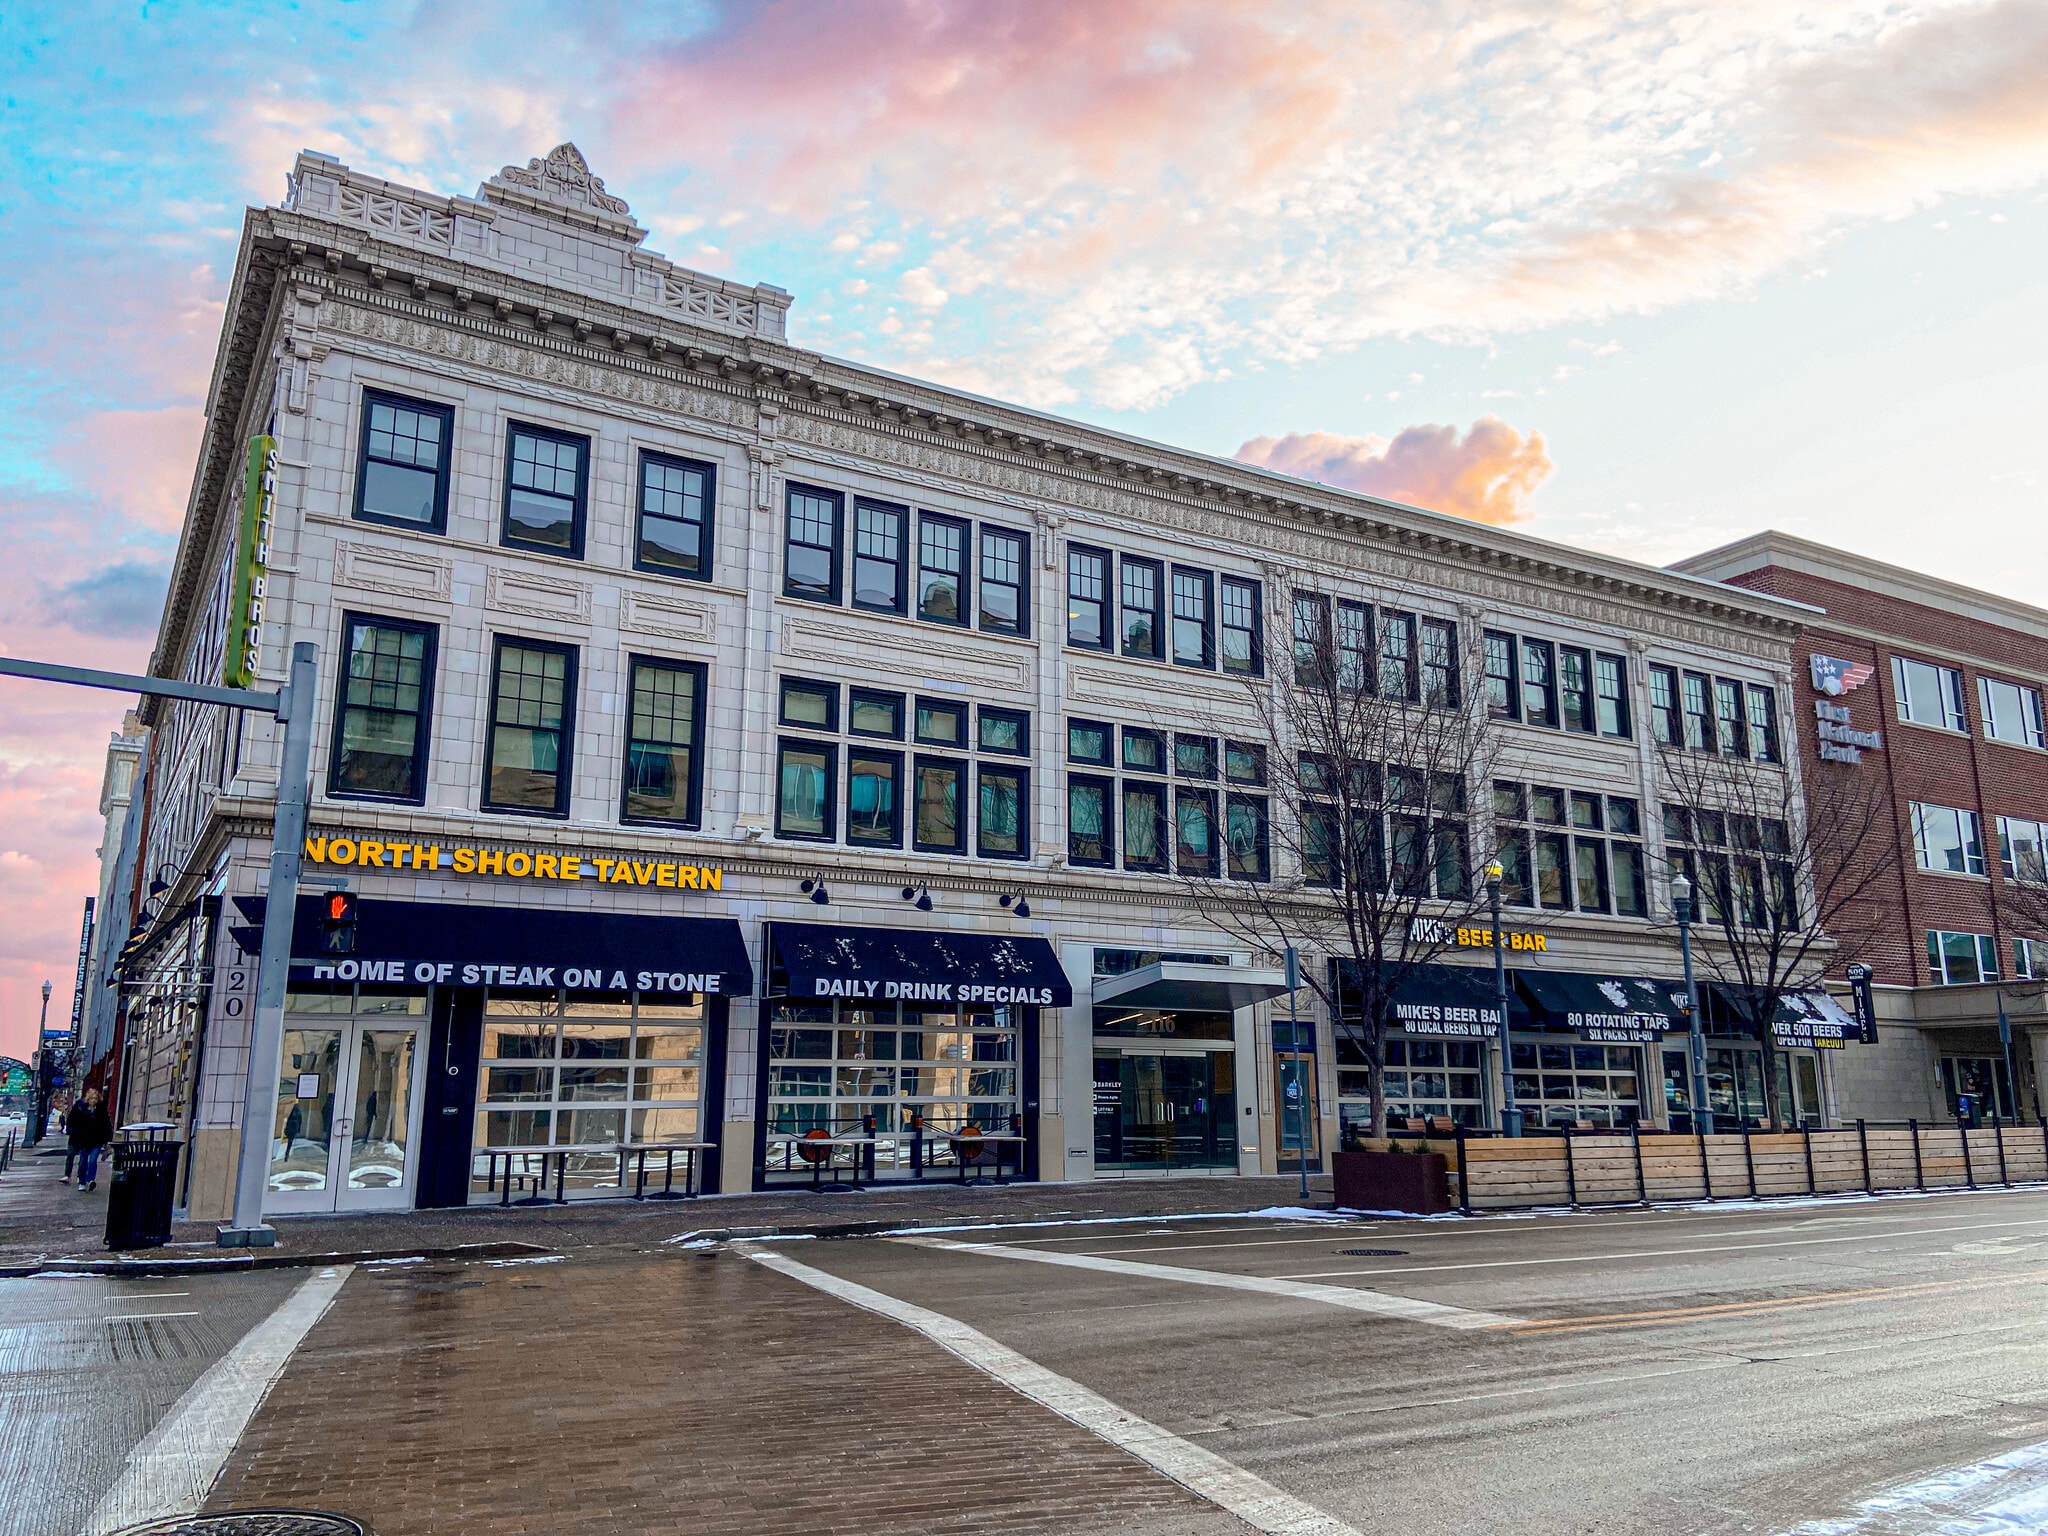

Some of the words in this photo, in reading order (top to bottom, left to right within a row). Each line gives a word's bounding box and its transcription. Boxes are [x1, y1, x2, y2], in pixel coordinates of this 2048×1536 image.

[256, 448, 278, 566] SMITH
[247, 576, 265, 672] BROS
[304, 837, 439, 871] NORTH
[452, 848, 581, 881] SHORE
[592, 858, 722, 891] TAVERN
[80, 910, 91, 952] Museum
[1510, 932, 1547, 952] BAR
[76, 955, 86, 990] Warhol
[314, 960, 405, 982] HOME
[414, 963, 453, 983] OF
[462, 964, 555, 986] STEAK
[563, 968, 602, 988] ON
[609, 971, 628, 989] A
[637, 972, 721, 993] STONE
[815, 978, 879, 997] DAILY
[885, 982, 952, 1001] DRINK
[957, 984, 1053, 1004] SPECIALS
[73, 992, 83, 1018] Andy
[1397, 1004, 1441, 1020] MIKE'S
[1444, 1007, 1478, 1022] BEER
[1855, 986, 1868, 1042] MIKE'S
[1405, 1020, 1416, 1032] 80
[1417, 1021, 1443, 1034] LOCAL
[1443, 1022, 1469, 1035] BEERS
[1470, 1023, 1481, 1035] ON
[1483, 1024, 1497, 1036] TAP
[1567, 1012, 1582, 1026] 80
[1585, 1013, 1640, 1029] ROTATING
[1642, 1016, 1670, 1030] TAPS
[1771, 1022, 1792, 1035] VER
[1793, 1024, 1811, 1036] 500
[1812, 1025, 1843, 1037] BEERS
[1588, 1028, 1602, 1040] SIX
[1603, 1029, 1627, 1040] PACKS
[1630, 1030, 1653, 1041] TO-GO
